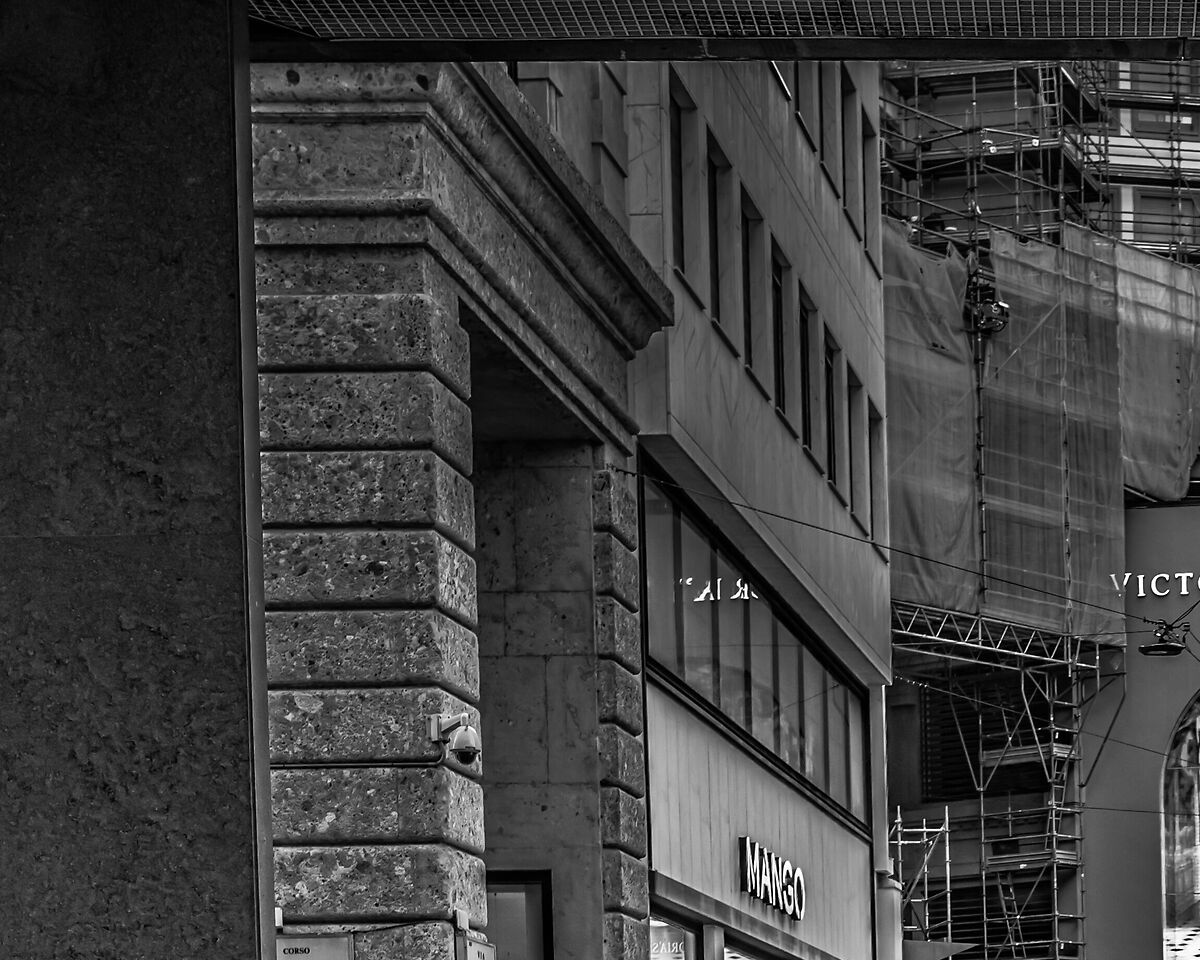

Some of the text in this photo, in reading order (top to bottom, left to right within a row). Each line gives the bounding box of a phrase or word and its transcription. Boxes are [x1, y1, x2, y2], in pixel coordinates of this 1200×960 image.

[745, 835, 806, 921] MANGO
[282, 947, 311, 955] CORSO
[477, 950, 486, 960] VIA
